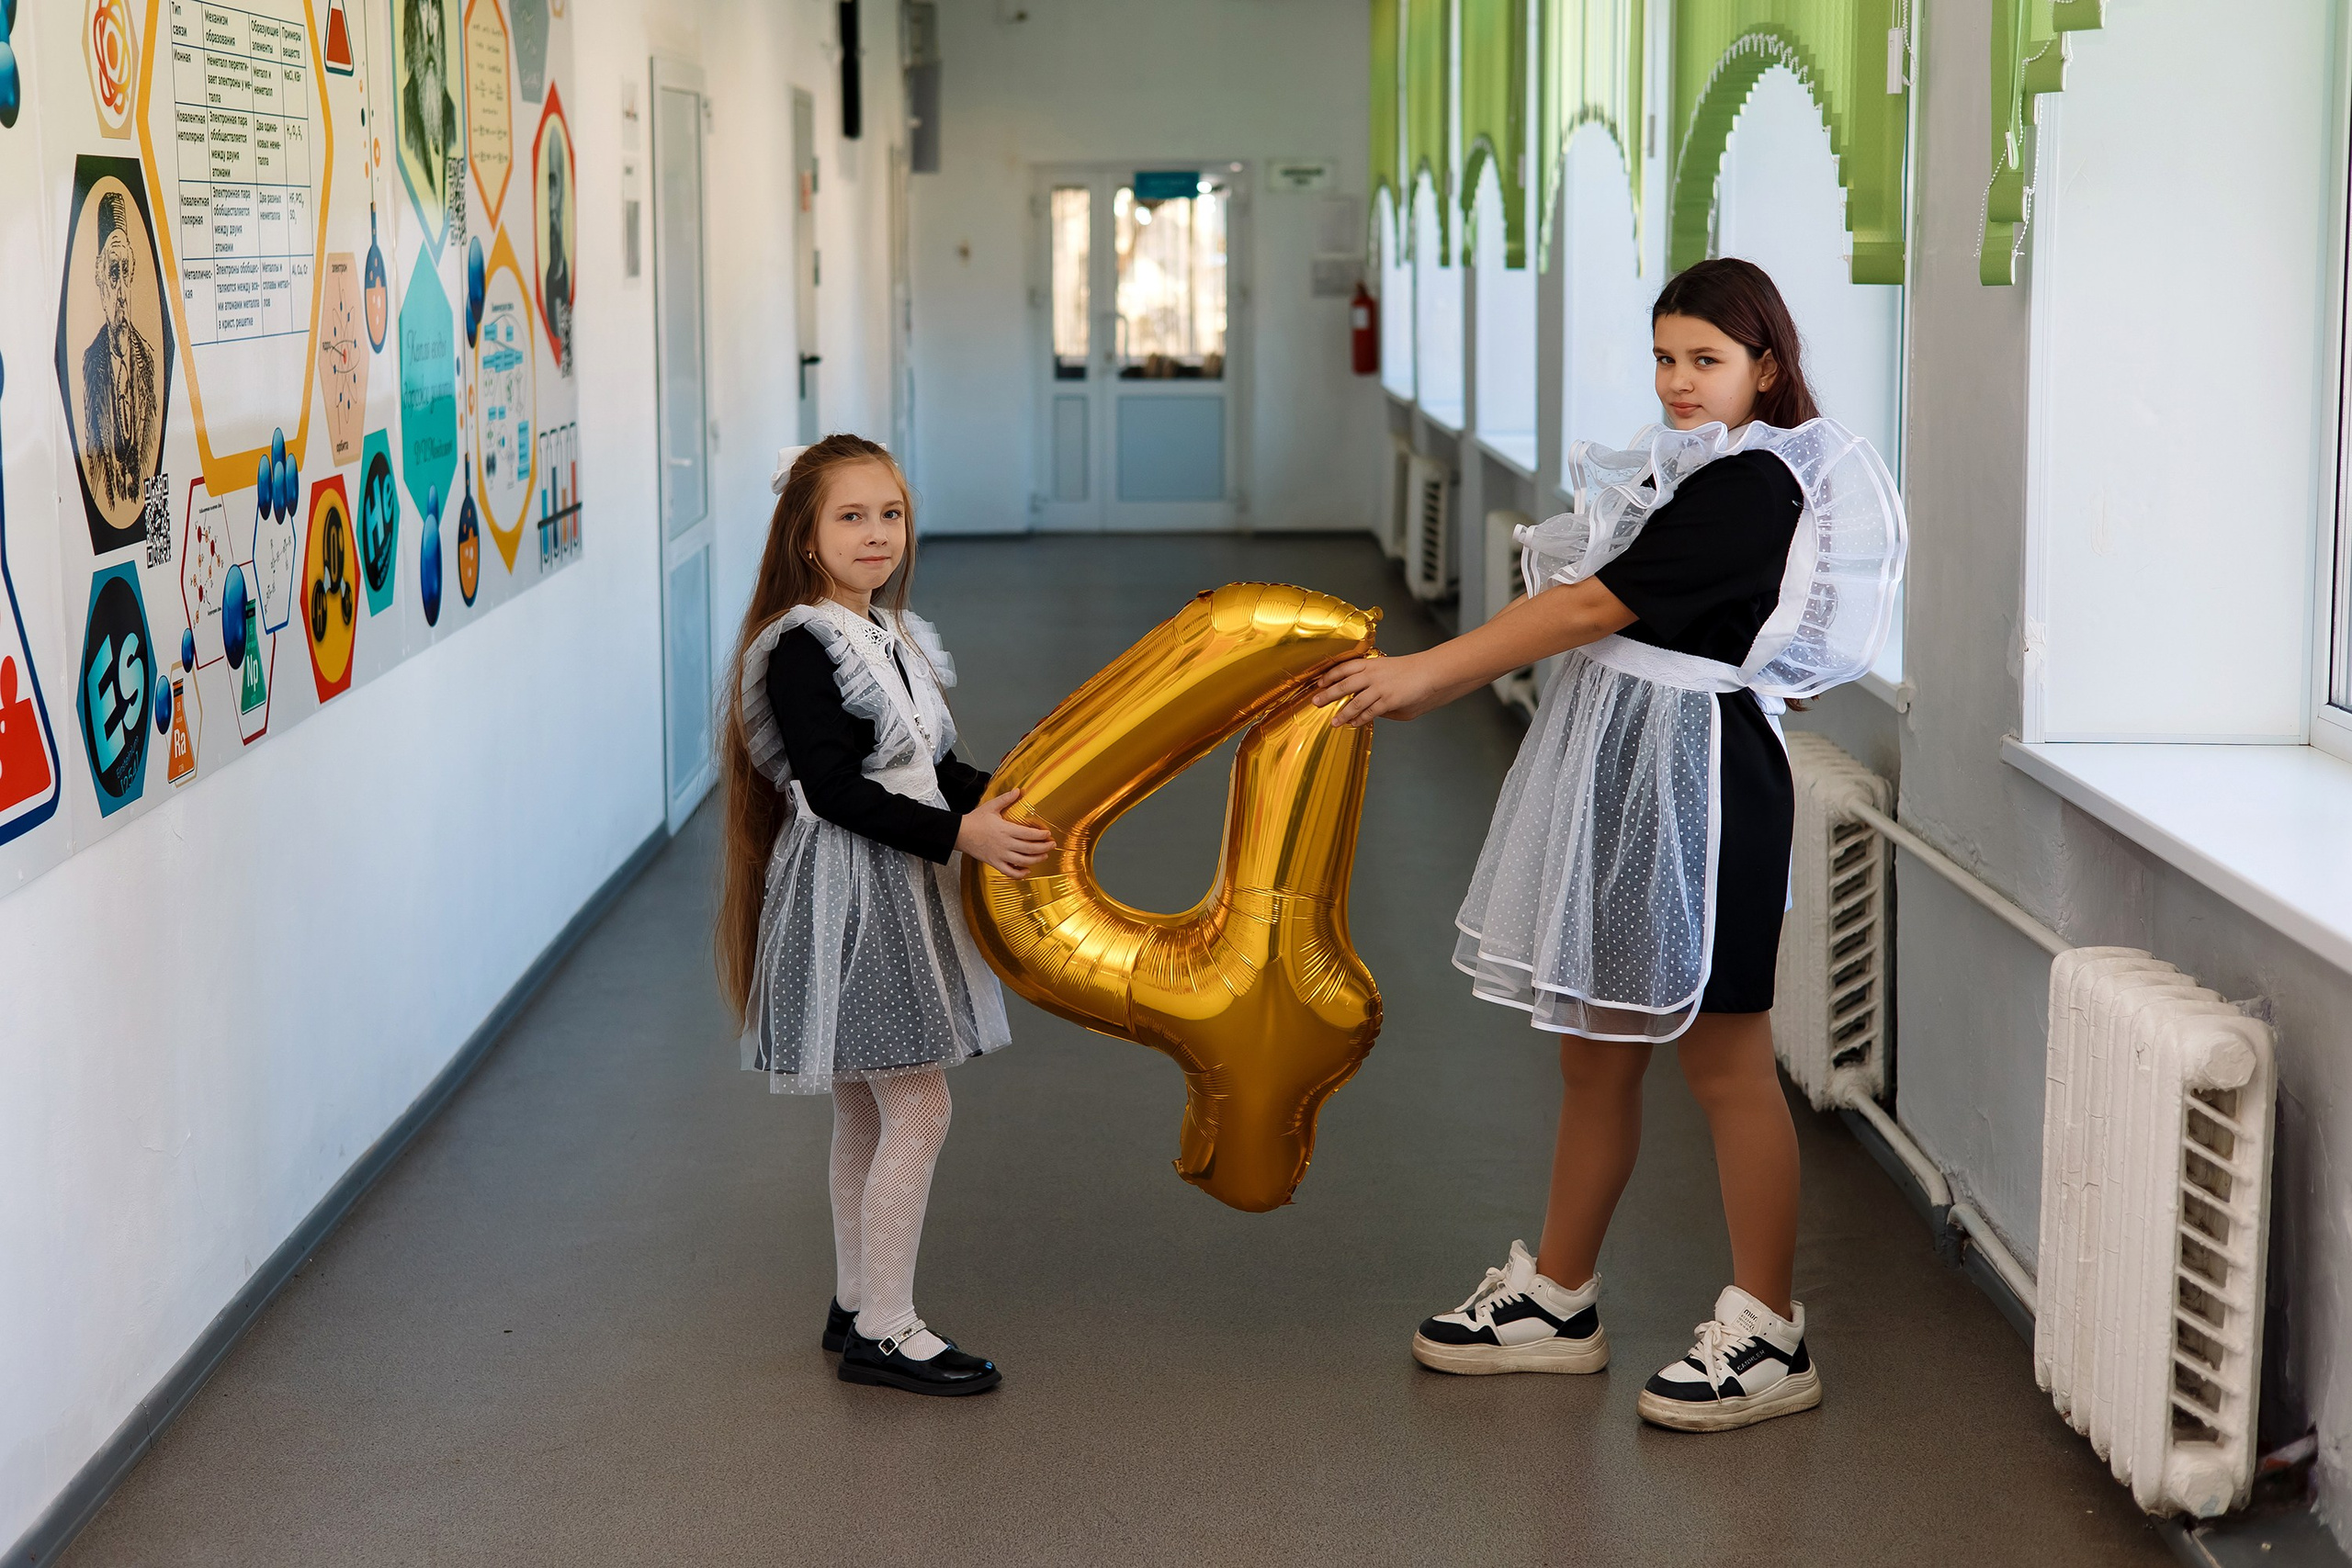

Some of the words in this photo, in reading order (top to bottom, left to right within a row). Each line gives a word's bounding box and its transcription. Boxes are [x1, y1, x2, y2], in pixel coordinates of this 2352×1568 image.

[172, 2, 181, 16] Тип
[205, 9, 228, 26] Механизм
[173, 25, 187, 37] связи
[251, 20, 279, 37] Образующие
[282, 27, 301, 41] Примеры
[206, 29, 235, 46] образования
[252, 41, 274, 54] элементы
[174, 49, 191, 63] Ионная
[207, 54, 228, 69] Неметалл
[254, 66, 267, 79] Металл
[208, 74, 218, 85] вает
[218, 75, 242, 89] электроны
[254, 85, 273, 96] неметалл
[209, 93, 221, 103] талла
[176, 110, 206, 124] Ковалентная
[209, 111, 237, 125] Электронная
[237, 115, 248, 127] пара
[256, 119, 265, 131] Два
[178, 131, 205, 145] неполярная
[211, 150, 226, 162] между
[227, 151, 240, 163] двумя
[212, 168, 231, 177] атомами
[213, 186, 241, 199] Электронная
[241, 189, 251, 200] пара
[181, 195, 209, 207] Ковалентная
[182, 215, 203, 228] полярная
[214, 225, 229, 236] между
[230, 225, 243, 236] двумя
[215, 243, 233, 253] атомами
[184, 268, 212, 280] Металличес-
[216, 264, 239, 276] Электроны
[185, 289, 193, 299] кая
[365, 472, 395, 563] He
[246, 653, 258, 692] Np
[174, 728, 187, 759] Ra
